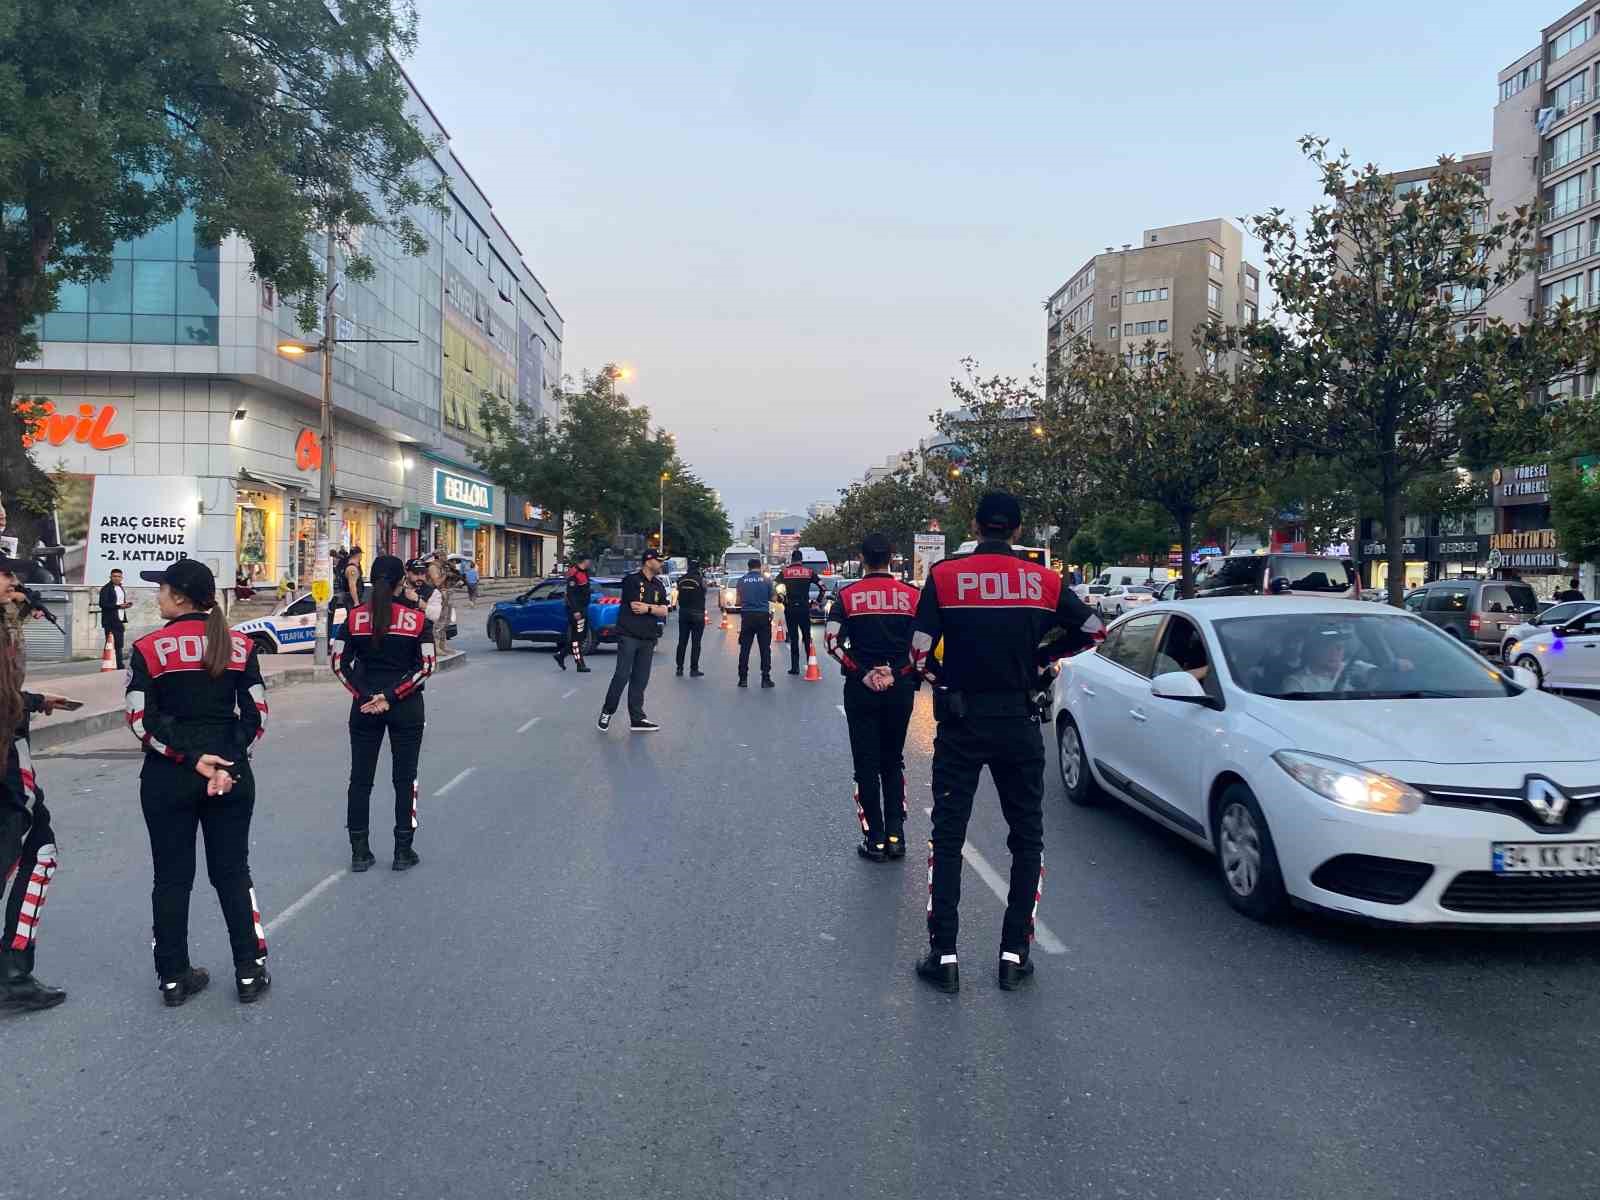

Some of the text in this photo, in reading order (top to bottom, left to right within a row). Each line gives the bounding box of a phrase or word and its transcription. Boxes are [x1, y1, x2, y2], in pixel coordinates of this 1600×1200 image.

[1503, 483, 1513, 496] ET
[100, 516, 187, 532] ARAÇ GEREÇ
[100, 533, 185, 545] REYONUMUZ
[100, 550, 120, 561] -2.
[957, 568, 1042, 600] POLİS
[851, 587, 912, 611] POLİS
[354, 608, 417, 632] PİS
